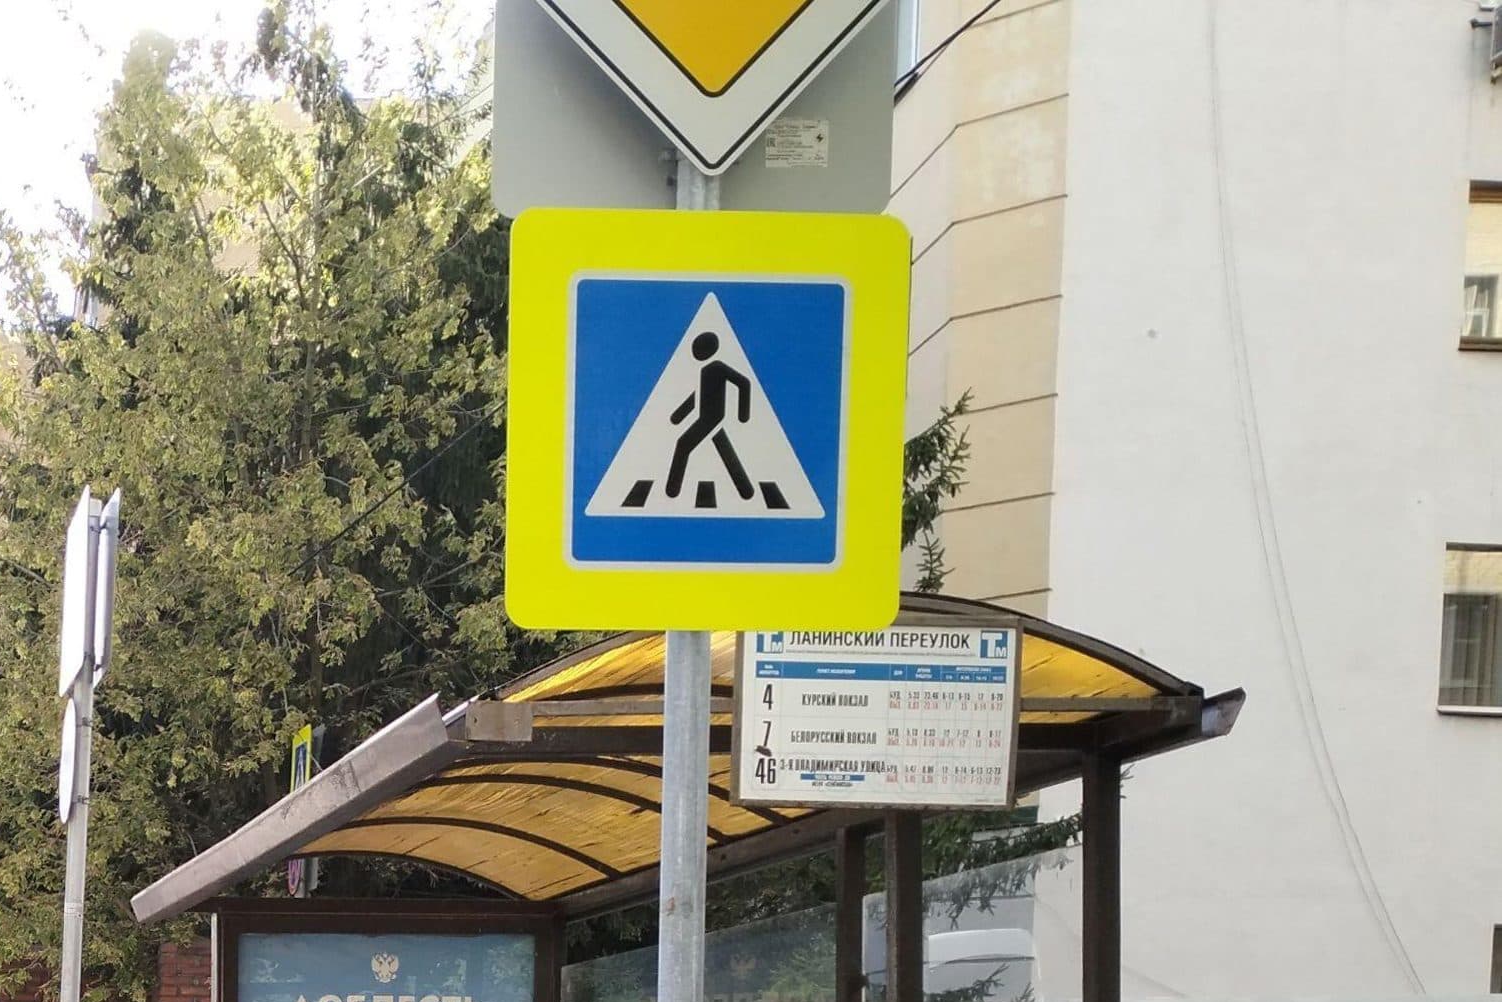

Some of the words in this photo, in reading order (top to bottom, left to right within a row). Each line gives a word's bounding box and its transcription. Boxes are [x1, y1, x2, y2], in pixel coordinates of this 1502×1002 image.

[889, 632, 971, 649] ПЕРЕУЛОК
[762, 683, 773, 710] 4
[801, 692, 837, 706] КУРСКИЙ
[838, 694, 869, 707] ВОКЗАЛ
[762, 720, 772, 745] 7
[791, 729, 845, 743] БЕЛОРУССКИЙ
[847, 732, 877, 745] ВОКЗАЛ
[755, 758, 776, 784] 46
